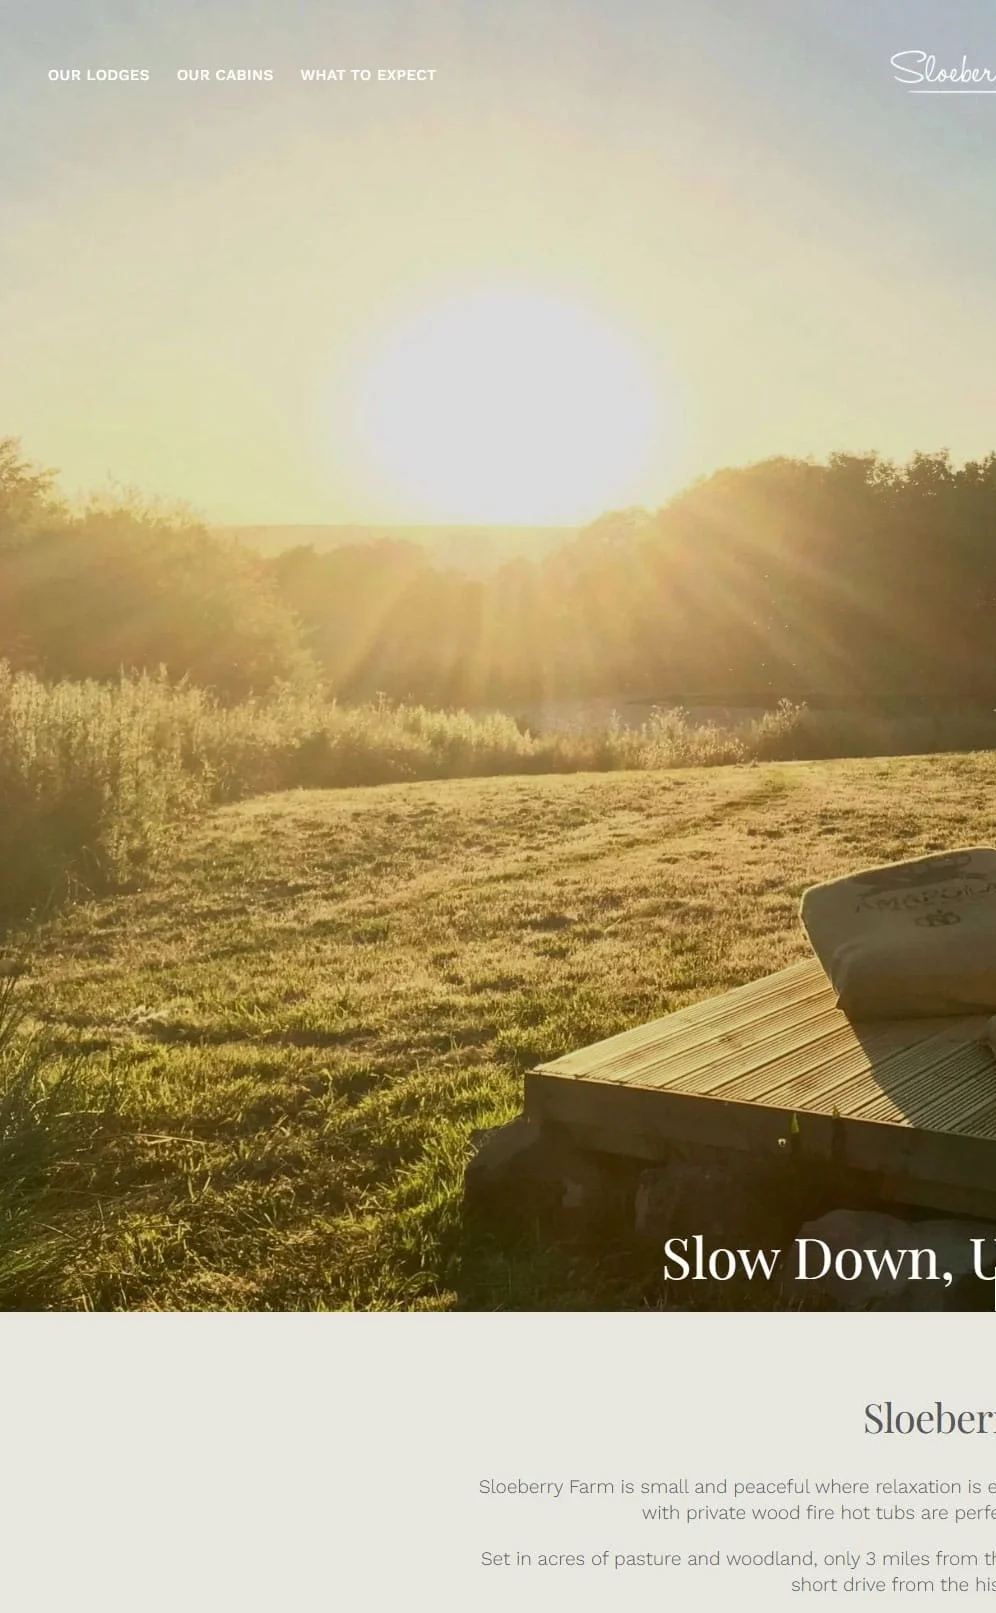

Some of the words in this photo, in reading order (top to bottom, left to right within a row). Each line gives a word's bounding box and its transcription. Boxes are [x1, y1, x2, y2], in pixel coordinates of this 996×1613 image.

[479, 1478, 564, 1498] Sloeberry
[569, 1479, 614, 1495] Farm
[621, 1479, 635, 1494] is
[640, 1478, 690, 1494] small
[694, 1478, 727, 1494] and
[734, 1478, 811, 1498] peaceful
[815, 1478, 870, 1494] where
[876, 1478, 962, 1494] relaxation
[968, 1479, 982, 1494] is
